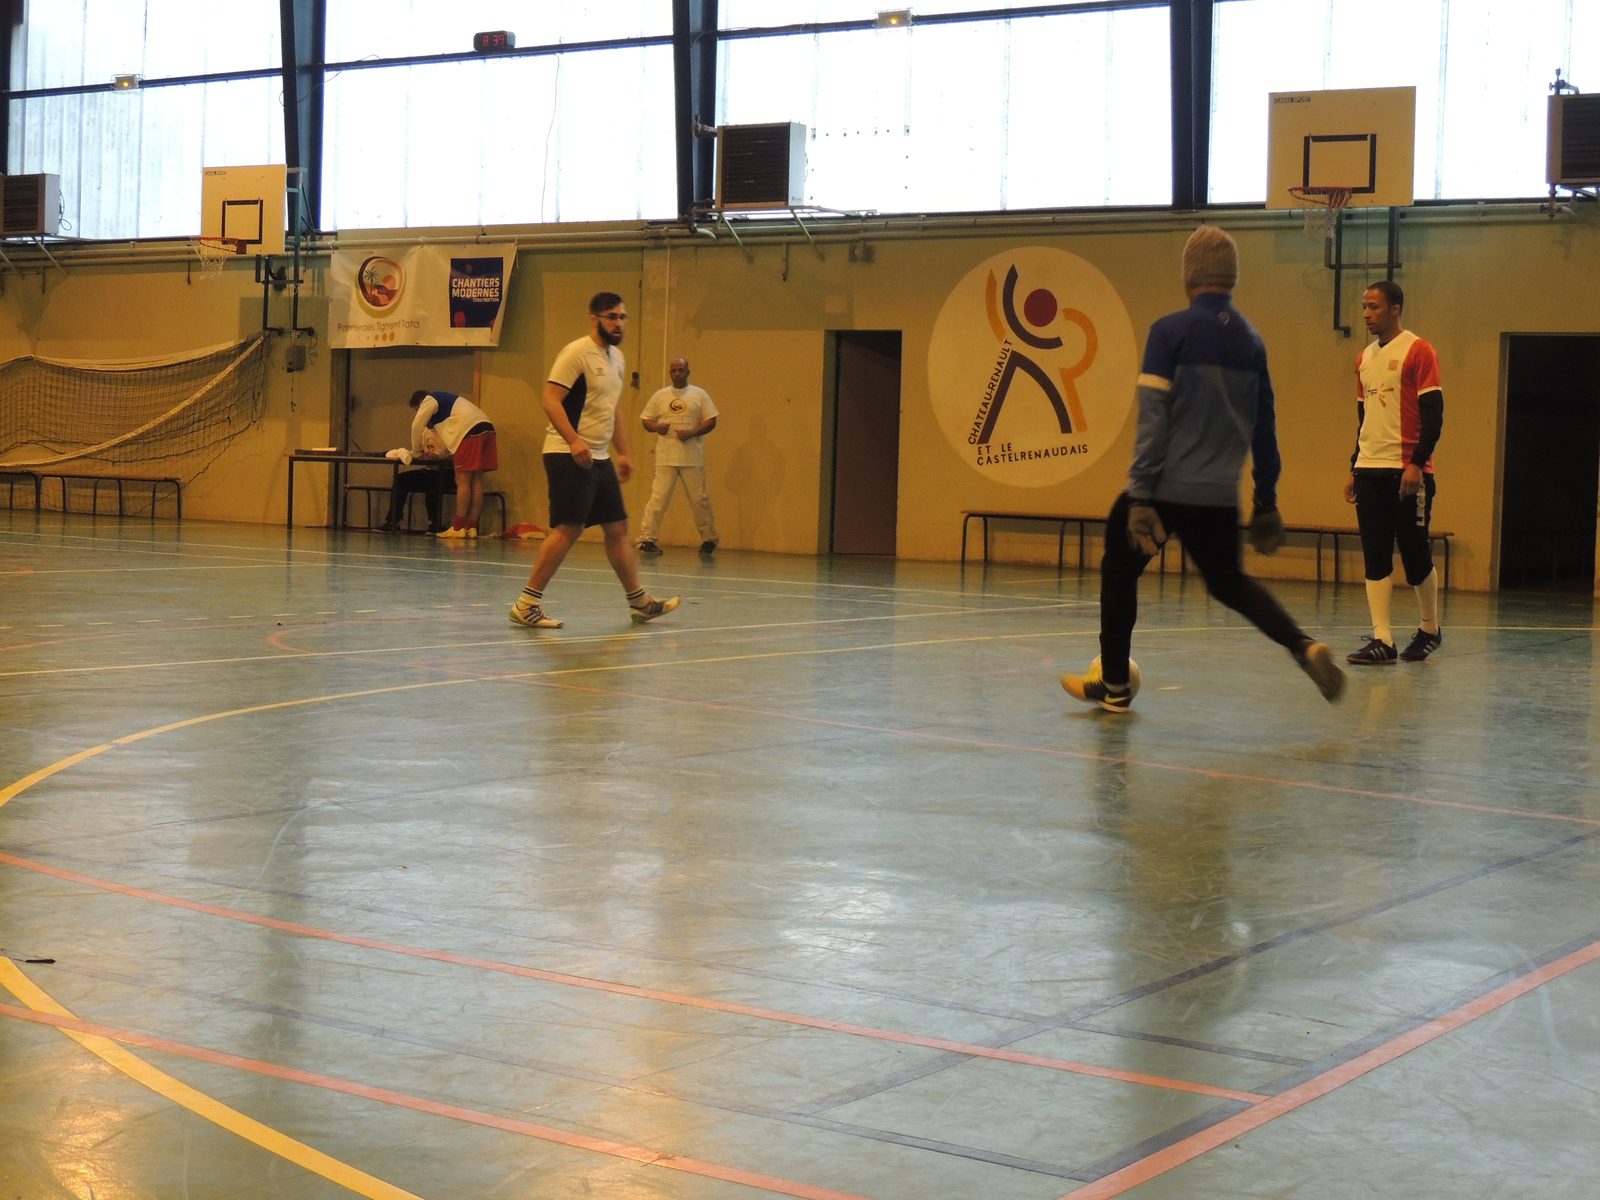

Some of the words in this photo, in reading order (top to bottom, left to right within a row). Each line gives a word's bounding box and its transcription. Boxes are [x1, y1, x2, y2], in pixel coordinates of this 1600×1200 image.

[452, 277, 500, 288] CHANTIERS
[452, 288, 500, 298] MODERNES
[968, 338, 1013, 445] CHATEAU-RENAULT
[977, 445, 991, 456] ET
[1001, 442, 1012, 453] LE
[977, 444, 1089, 466] CASTELRENAUDAIS
